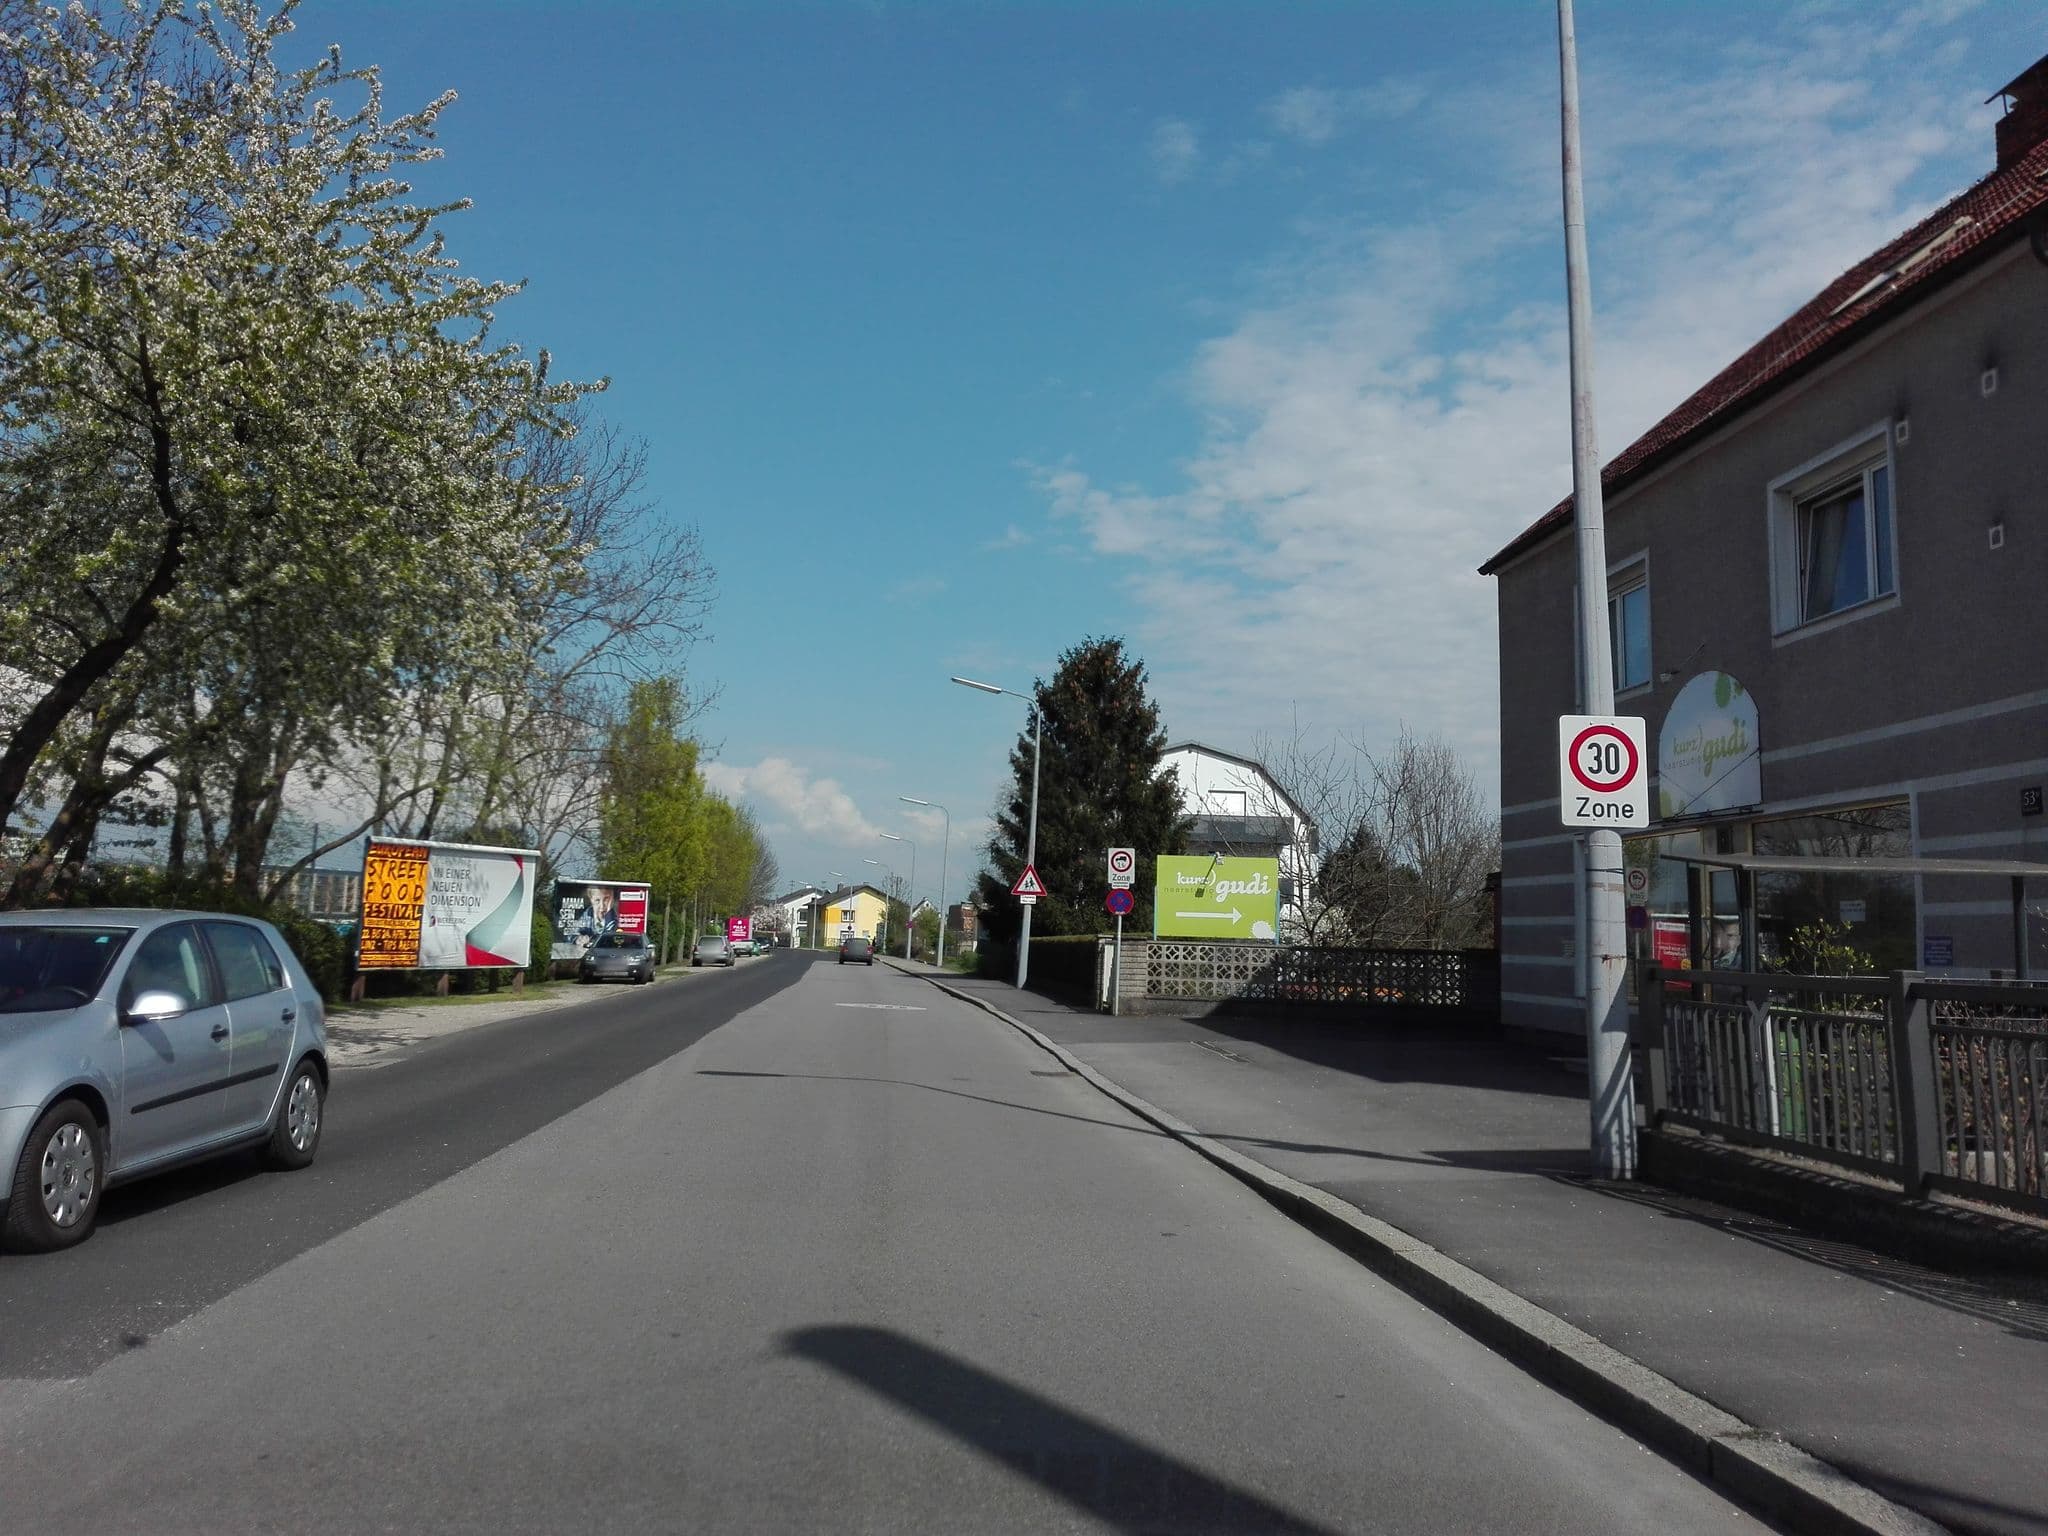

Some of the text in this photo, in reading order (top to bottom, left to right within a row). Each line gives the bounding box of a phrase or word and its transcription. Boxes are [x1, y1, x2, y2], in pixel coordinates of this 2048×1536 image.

[1702, 716, 1748, 778] gudi
[1587, 742, 1620, 775] 30
[1576, 797, 1634, 819] Zone
[367, 858, 427, 880] STREET
[446, 868, 470, 880] EINER
[1112, 873, 1131, 881] Zone
[366, 881, 425, 902] FOOD
[432, 881, 463, 892] NEUEN
[1215, 871, 1272, 903] gudi
[364, 903, 422, 918] FESTIVAL
[431, 894, 481, 907] DIMENSION
